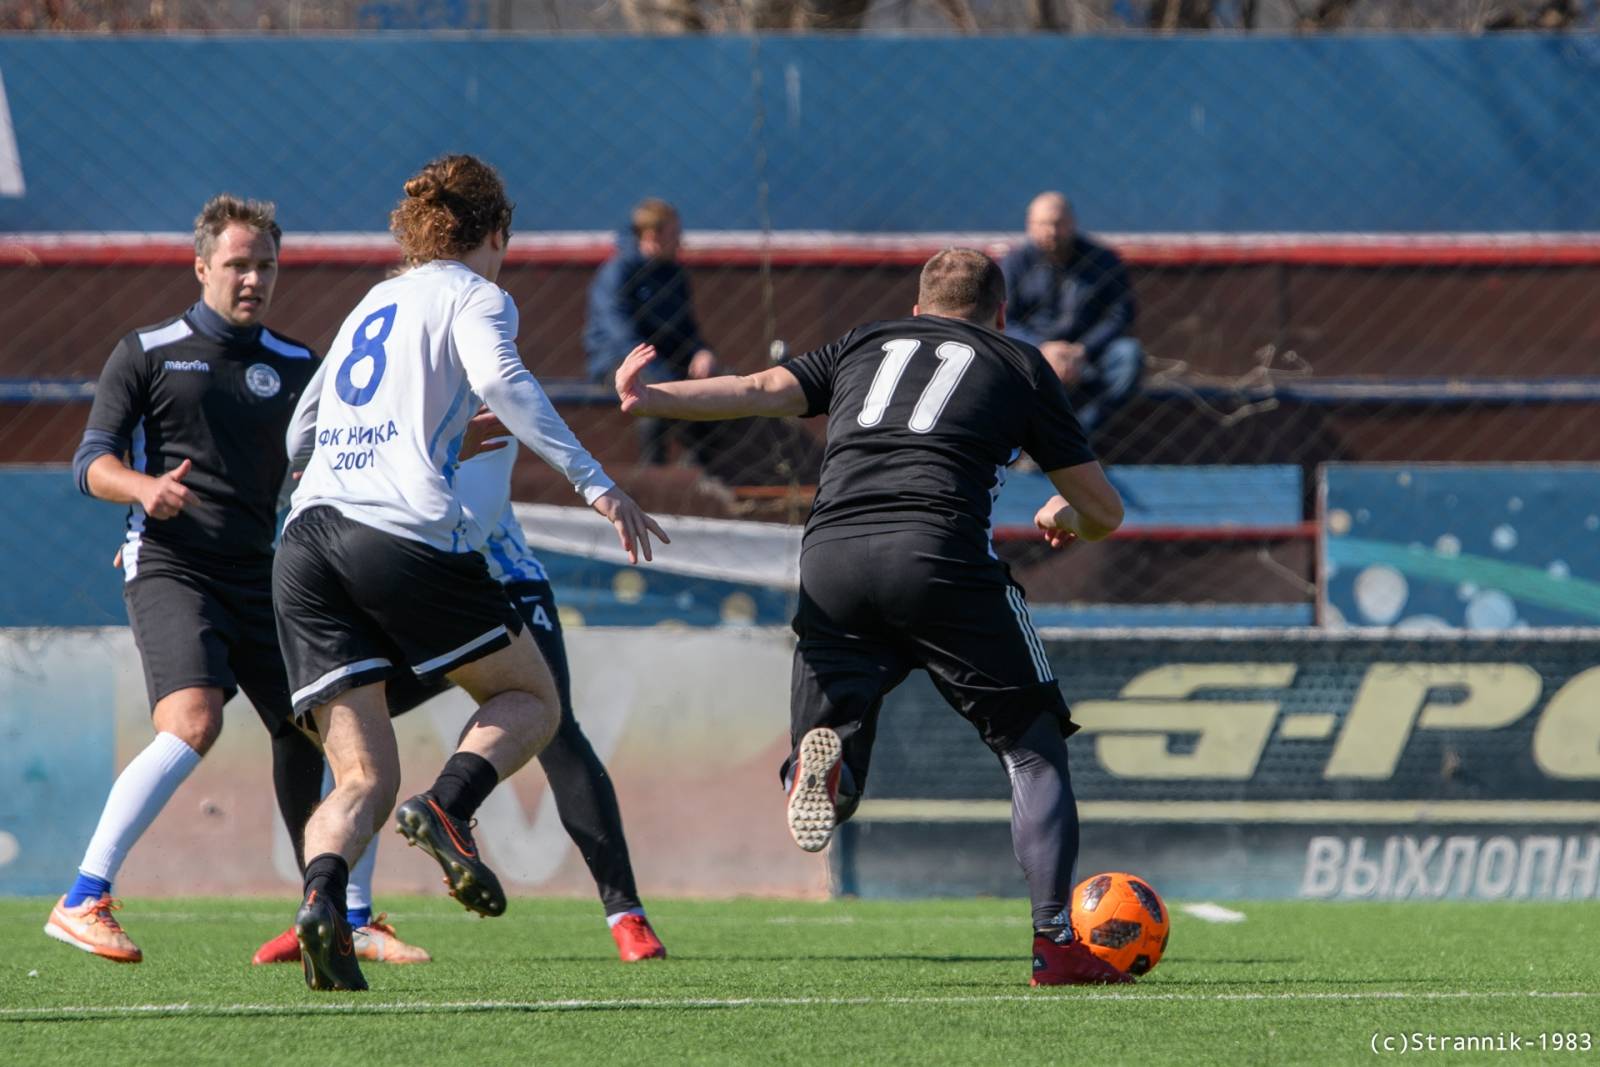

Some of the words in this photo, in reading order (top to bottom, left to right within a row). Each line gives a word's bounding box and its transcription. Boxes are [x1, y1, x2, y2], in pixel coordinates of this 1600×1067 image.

[164, 360, 210, 372] macron
[335, 302, 398, 407] 8
[857, 338, 976, 433] 11
[318, 428, 344, 447] ФК
[346, 419, 399, 446] НИКА
[333, 449, 375, 471] 2001
[532, 604, 553, 632] 4
[1302, 835, 1600, 898] ВЫХЛОПН
